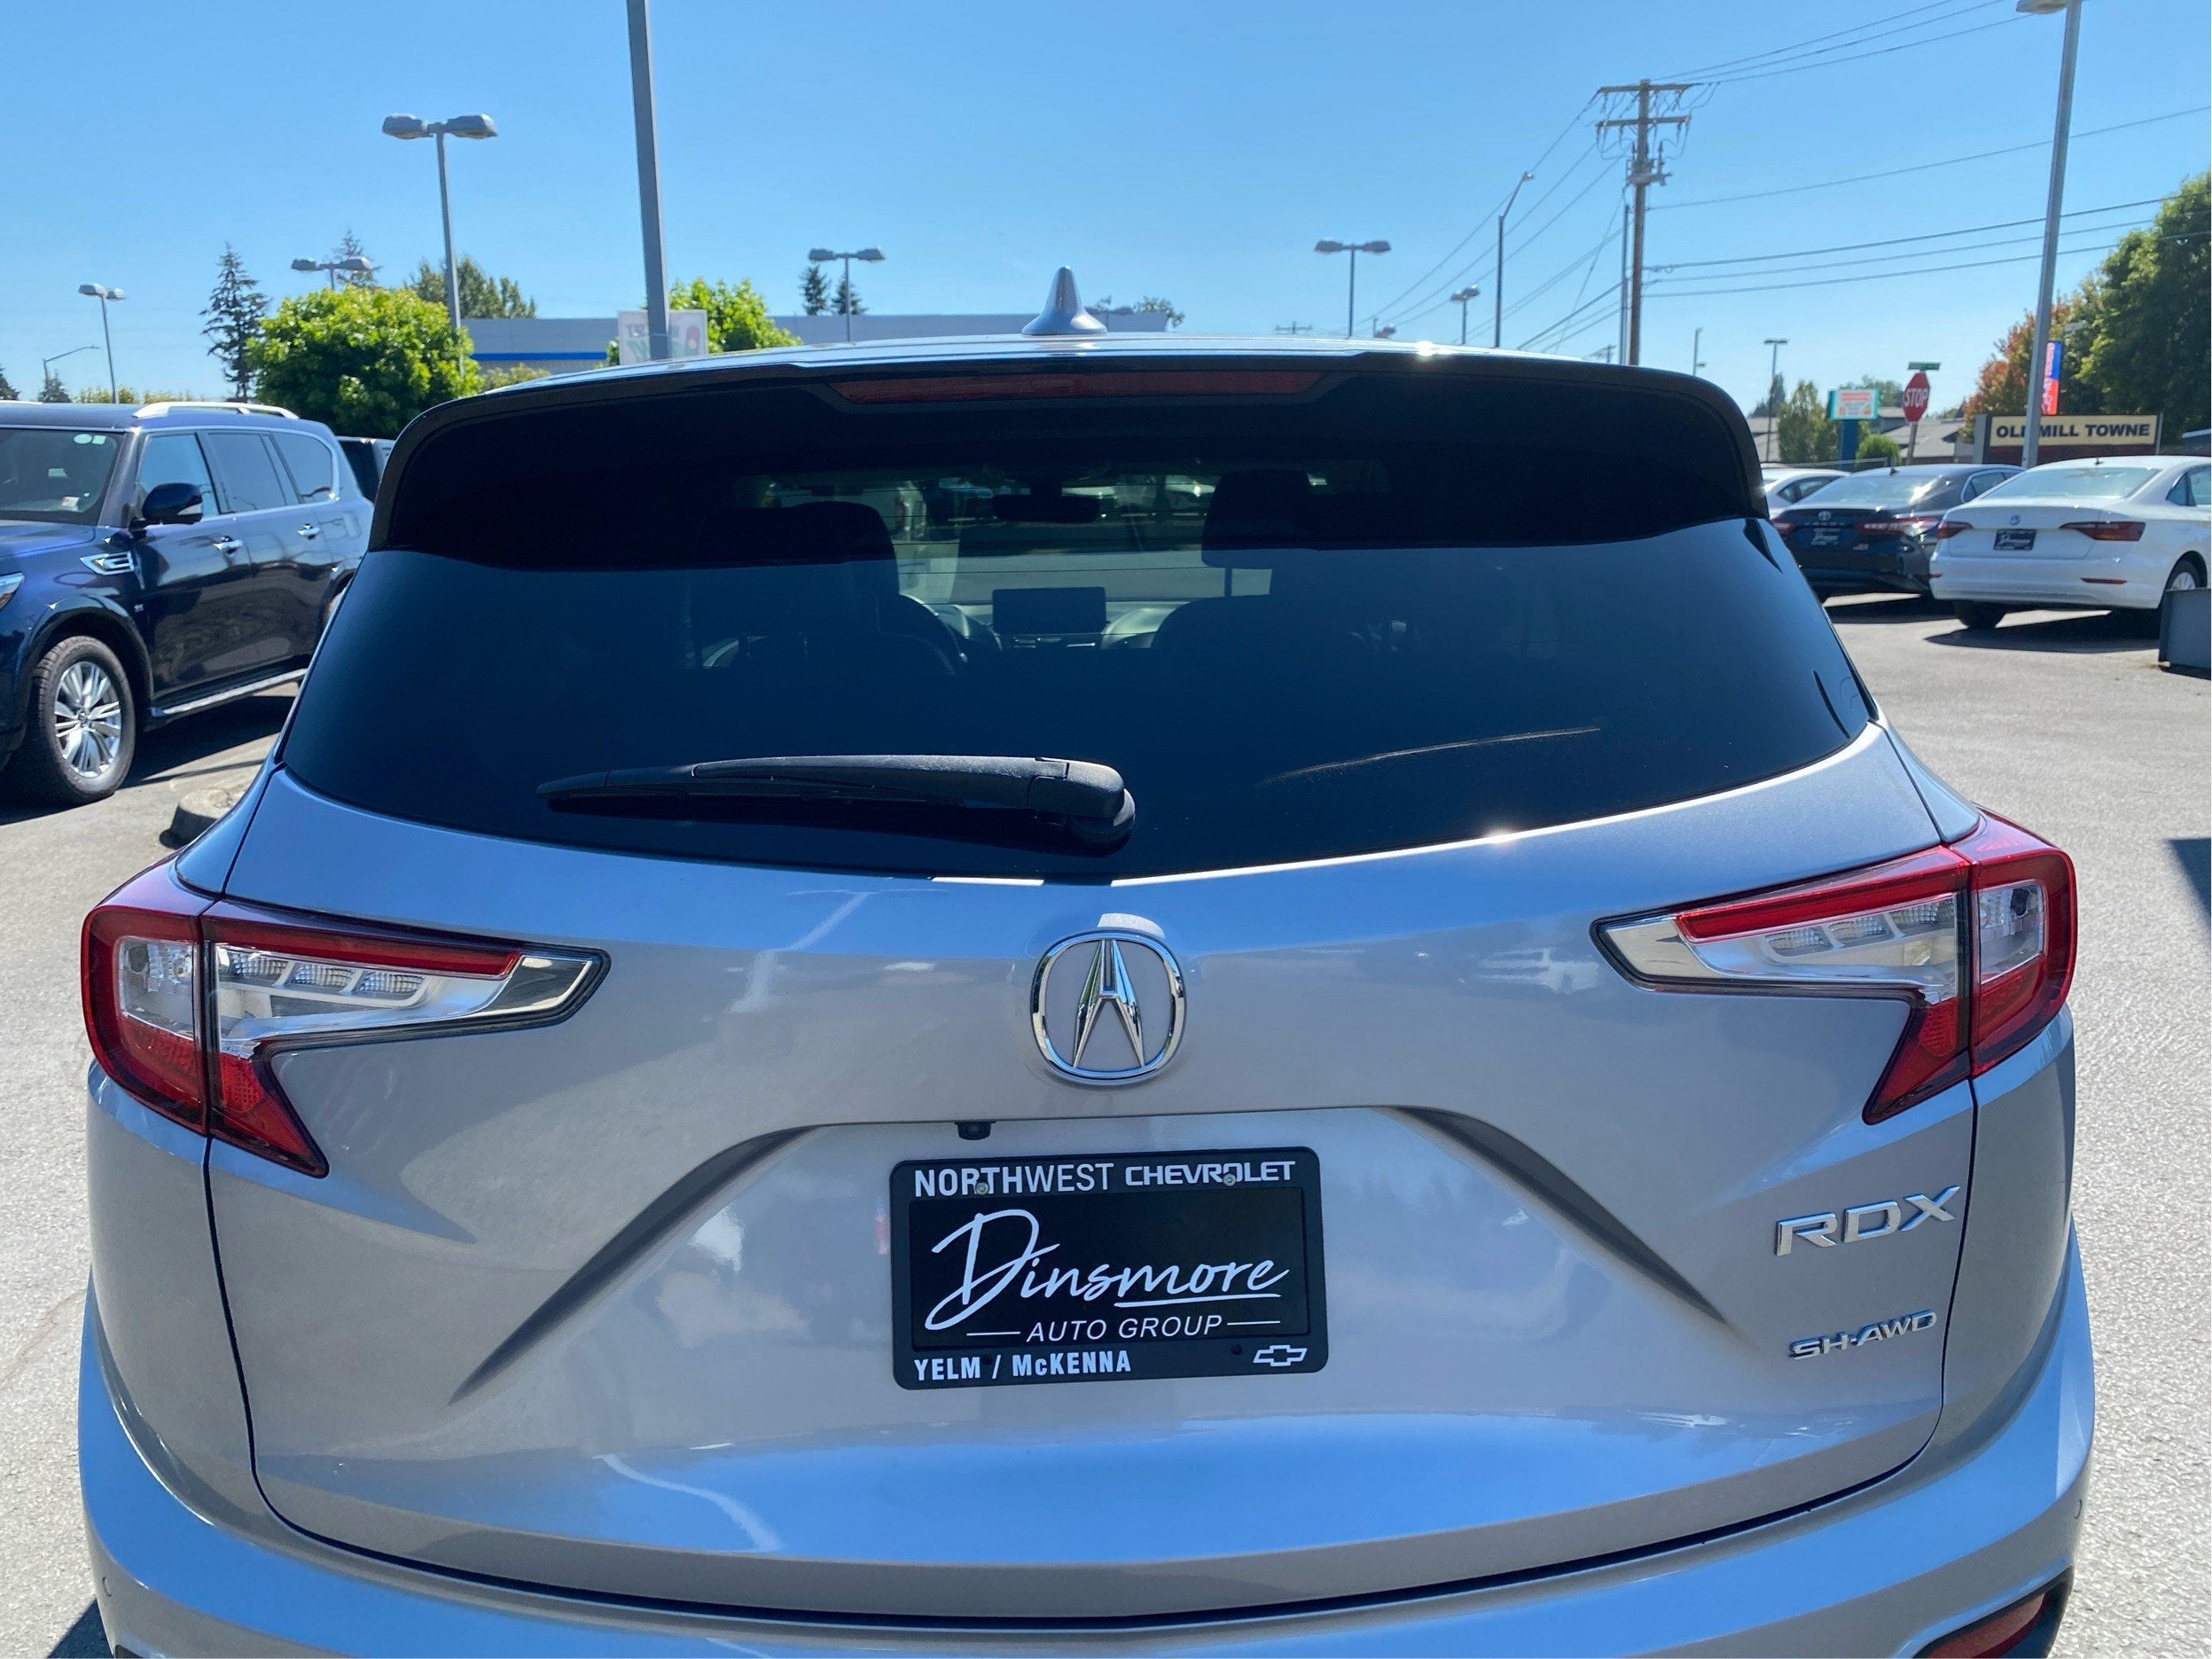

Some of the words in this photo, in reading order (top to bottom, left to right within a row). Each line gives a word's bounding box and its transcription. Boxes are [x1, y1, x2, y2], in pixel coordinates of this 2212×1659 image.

[1904, 388, 1929, 408] STOP
[2039, 424, 2079, 437] MILL
[2085, 423, 2151, 437] TOWNE
[914, 1162, 1114, 1198] NORTHWEST
[1125, 1160, 1296, 1186] CHEVROLET
[1774, 1185, 1960, 1256] RDX
[925, 1209, 1290, 1331] Dinsmore
[1026, 1318, 1107, 1343] AUTO
[1118, 1314, 1223, 1339] GROUP
[1788, 1309, 1937, 1360] SH-AWD
[914, 1356, 981, 1382] YELM
[1012, 1350, 1132, 1378] McKENNA
